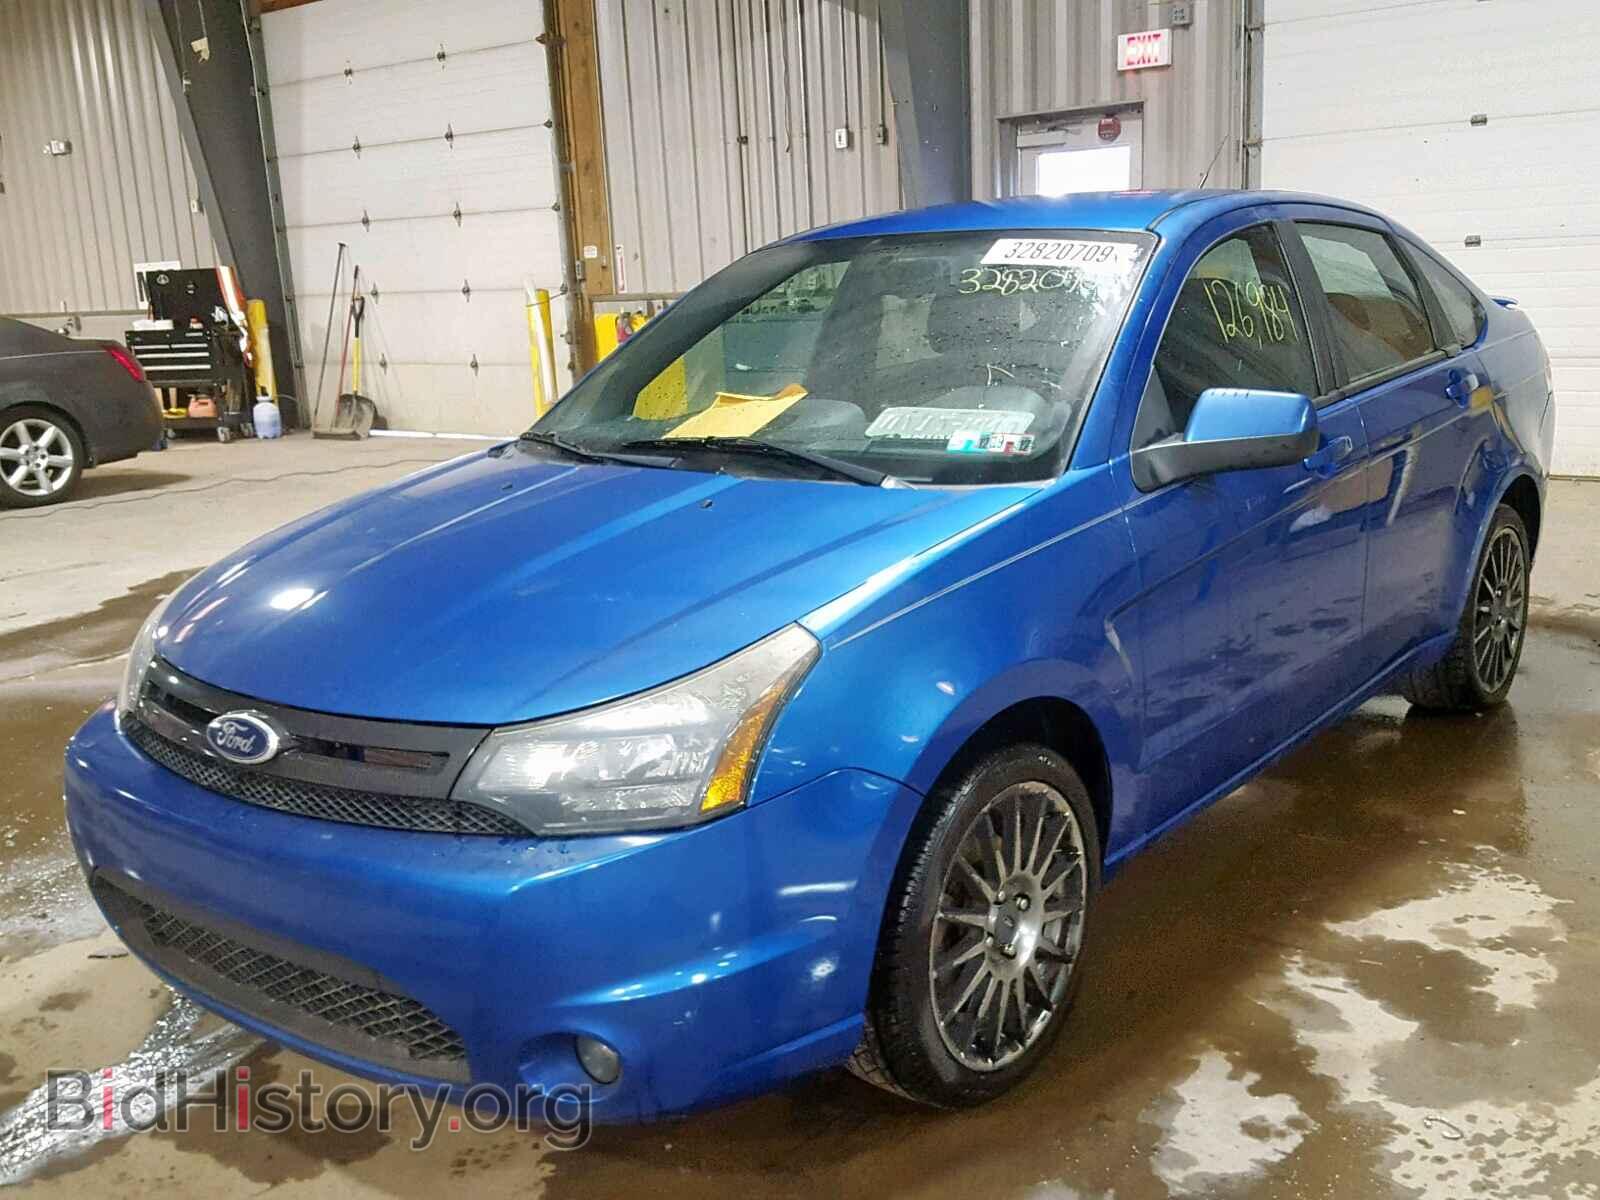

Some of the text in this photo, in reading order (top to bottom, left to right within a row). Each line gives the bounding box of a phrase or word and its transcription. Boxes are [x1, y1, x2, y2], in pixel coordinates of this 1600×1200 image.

[1126, 33, 1162, 66] EXIT
[1004, 241, 1115, 263] 32820709
[216, 720, 257, 753] Ford
